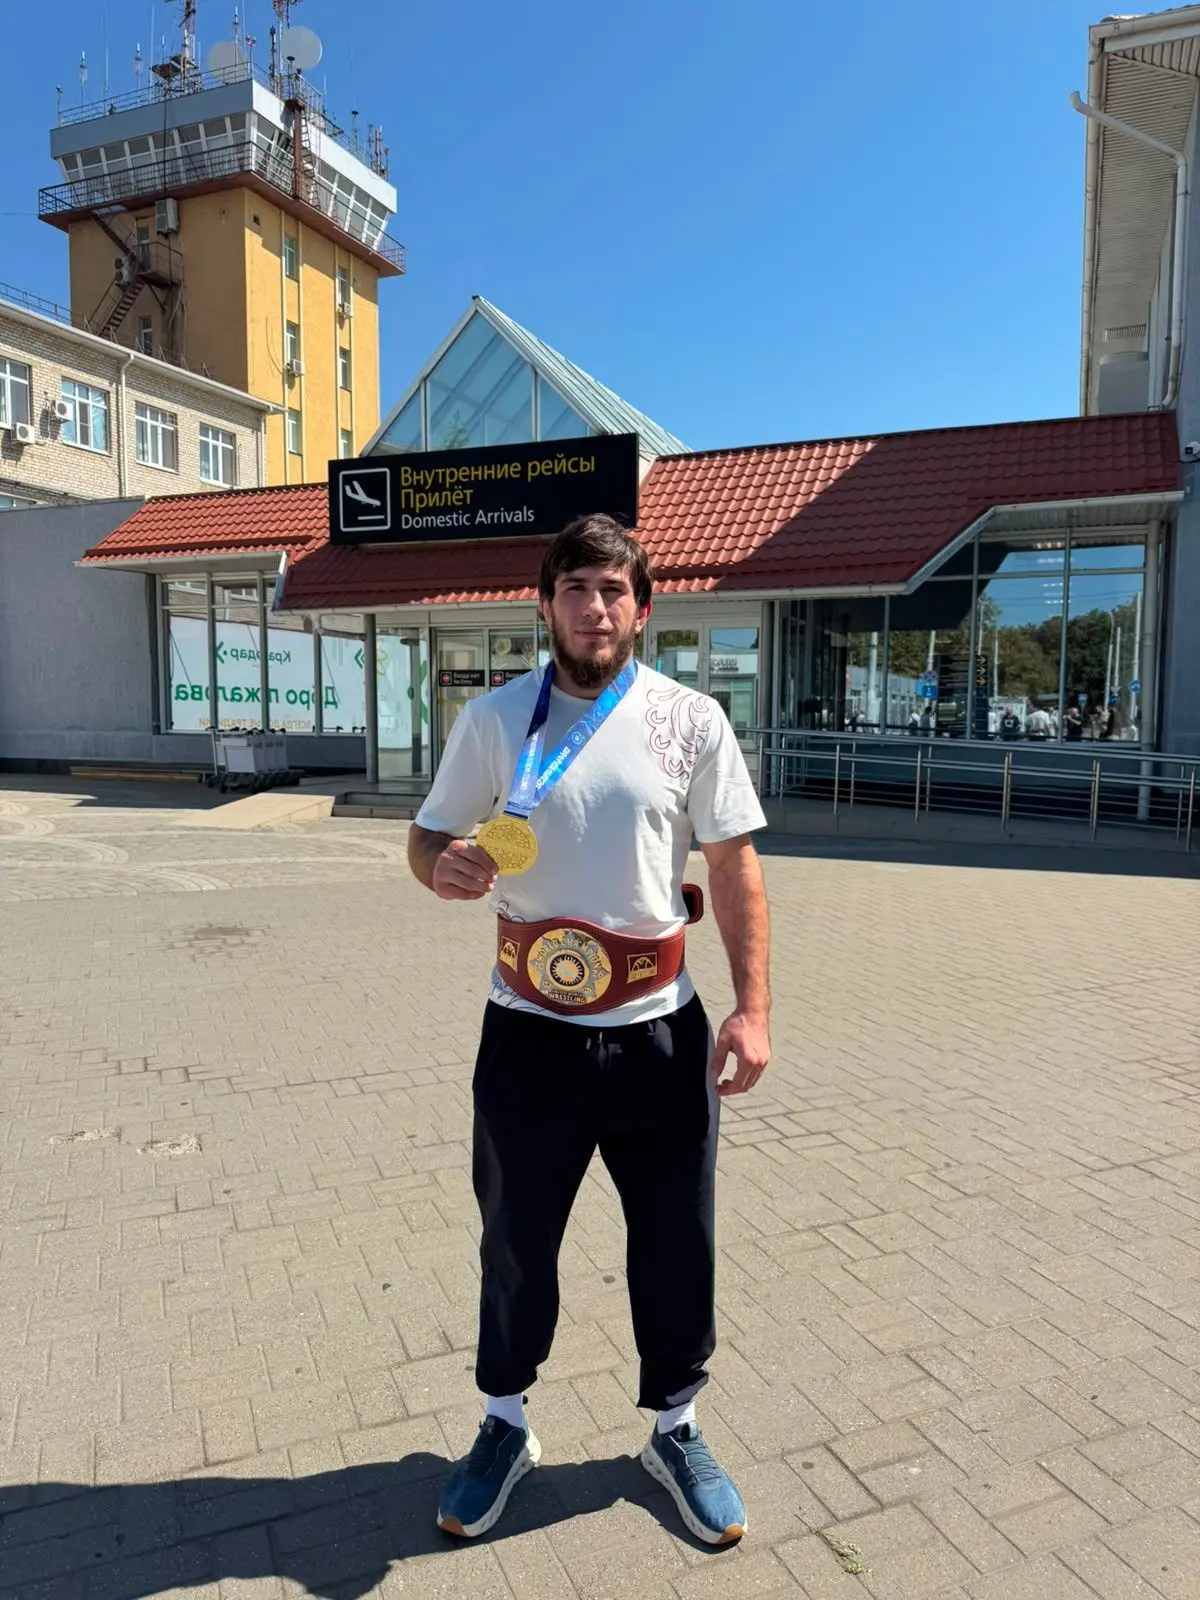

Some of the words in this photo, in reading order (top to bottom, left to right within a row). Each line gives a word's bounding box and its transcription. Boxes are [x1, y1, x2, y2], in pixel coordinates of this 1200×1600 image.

[400, 461, 521, 488] Внутренние
[527, 453, 596, 481] рейсы
[401, 486, 473, 511] Прилёт
[401, 511, 470, 529] Domestic
[475, 506, 535, 525] Arrivals
